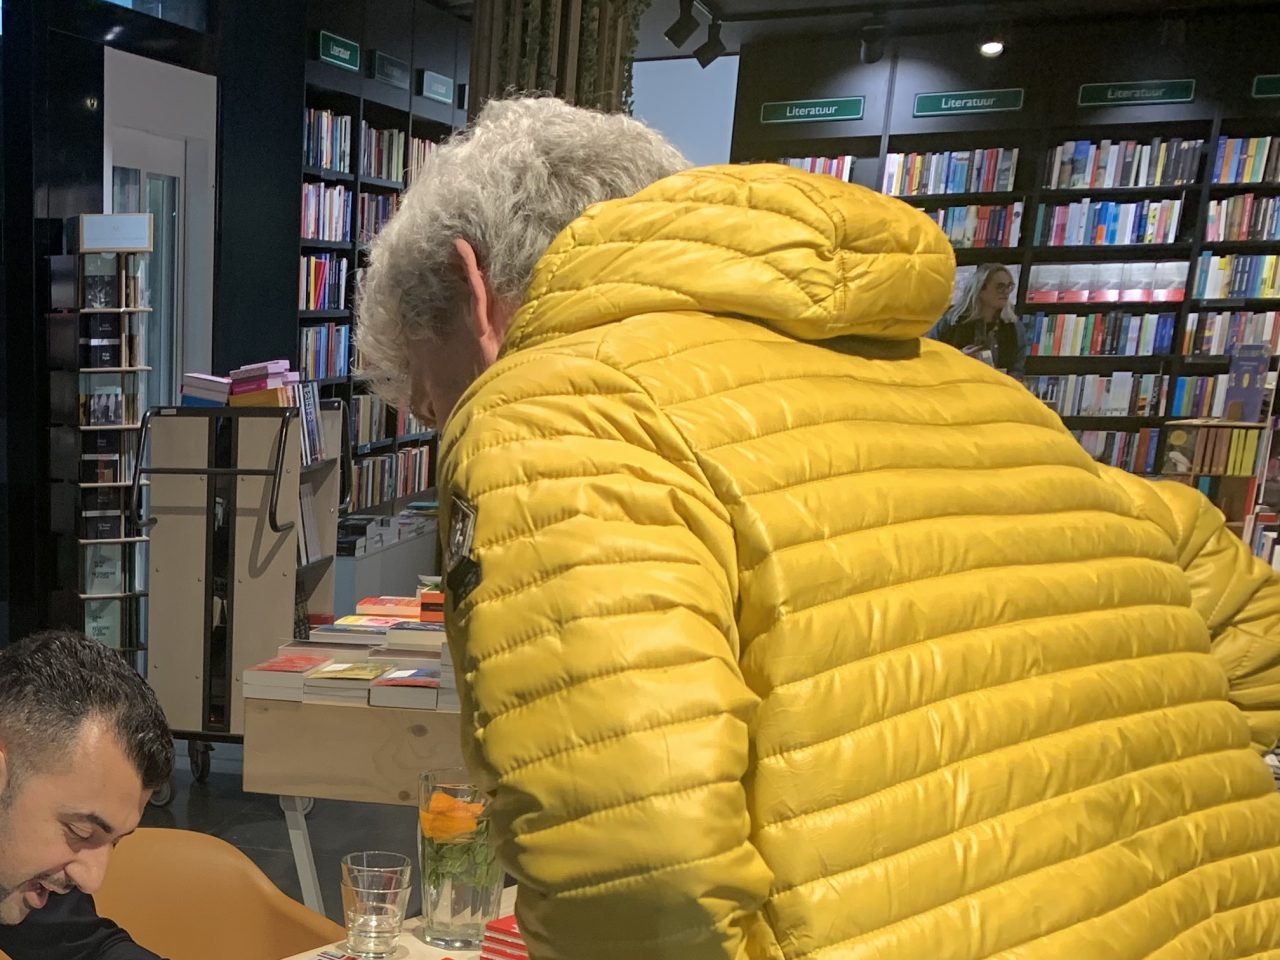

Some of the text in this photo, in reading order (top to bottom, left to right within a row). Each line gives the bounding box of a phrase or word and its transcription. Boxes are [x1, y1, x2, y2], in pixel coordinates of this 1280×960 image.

[1106, 86, 1167, 100] Literatuur
[941, 94, 996, 110] Literatuur
[786, 103, 838, 118] Literatuur
